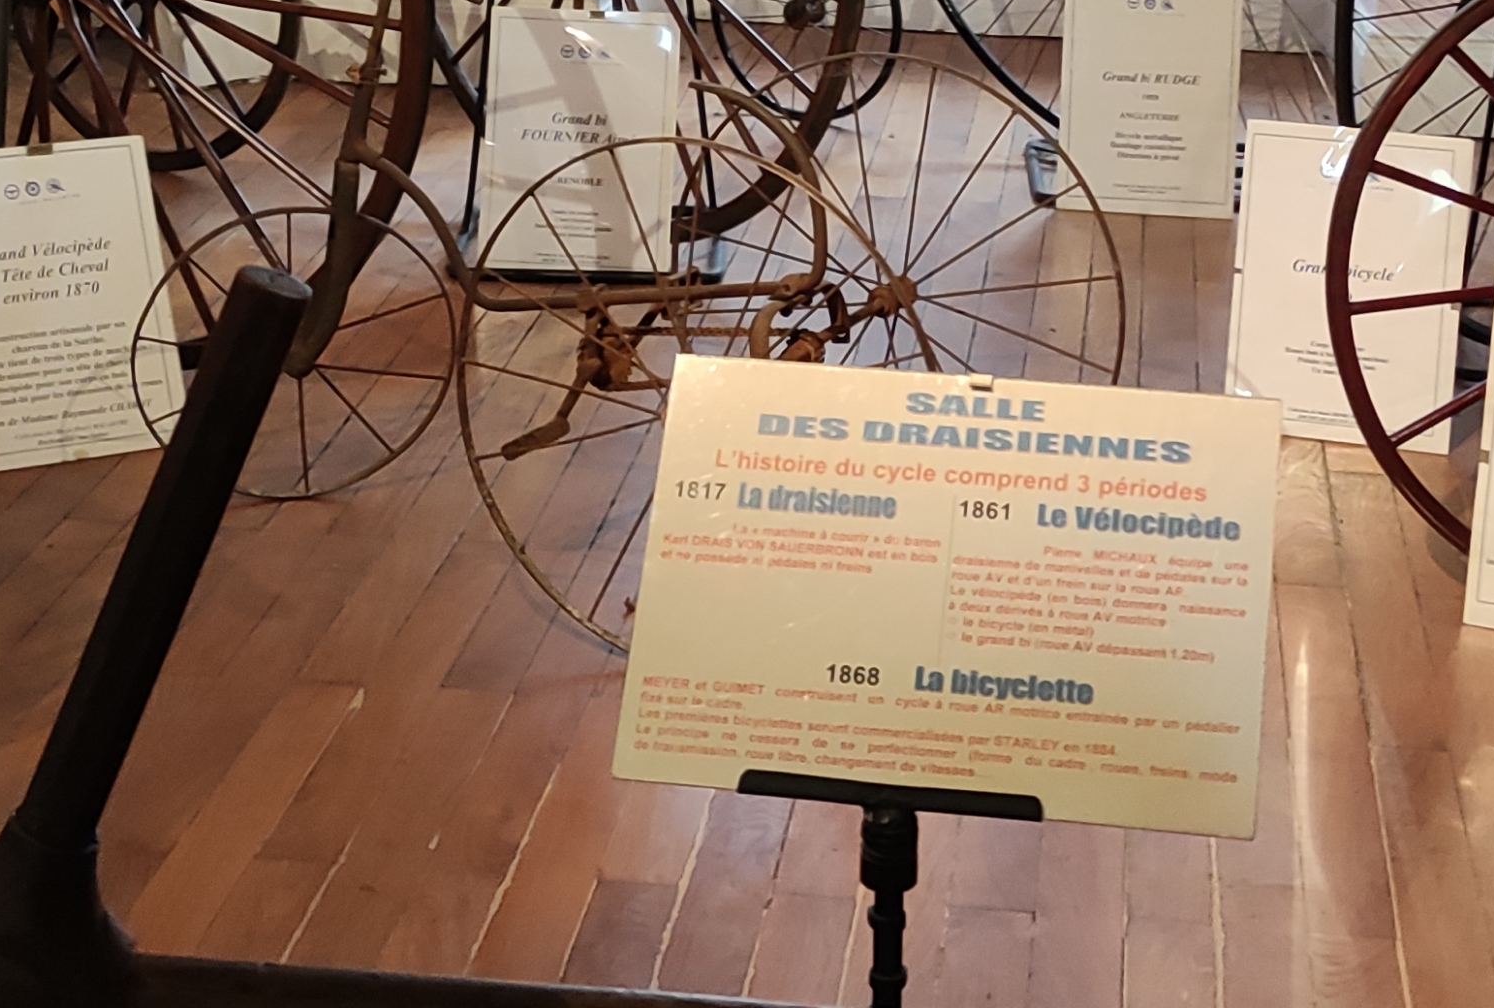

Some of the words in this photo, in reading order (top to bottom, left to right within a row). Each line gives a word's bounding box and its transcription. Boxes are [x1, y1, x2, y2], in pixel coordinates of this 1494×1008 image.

[1155, 73, 1202, 86] RUDGE
[552, 112, 591, 125] Grand
[595, 114, 607, 125] bi
[521, 129, 599, 144] FOURNIER
[32, 237, 111, 258] Vélocipède
[1, 268, 33, 283] Tête
[37, 264, 54, 278] de
[59, 258, 109, 277] Cheval
[3, 287, 59, 305] environ
[66, 281, 100, 297] 1870
[906, 391, 1046, 422] SALLE
[758, 413, 849, 440] DES
[862, 420, 1192, 464] DRAISIENNES
[715, 449, 827, 475] L'histoire
[836, 456, 865, 478] du
[873, 462, 936, 484] cycle
[945, 468, 1069, 492] comprend
[1077, 475, 1090, 492] 3
[1099, 476, 1207, 502] périodes
[675, 480, 726, 501] 1817
[737, 482, 762, 510] La
[768, 484, 897, 520] draisienne
[959, 500, 1011, 520] 1861
[1037, 503, 1067, 530] Le
[1075, 506, 1241, 542] Vélocipède
[1093, 550, 1157, 564] MICHAUX
[985, 572, 1004, 584] AV
[1093, 611, 1113, 622] AV
[1072, 640, 1093, 653] AV
[826, 664, 880, 686] 1868
[914, 665, 944, 693] La
[950, 668, 1095, 705] bicyclette
